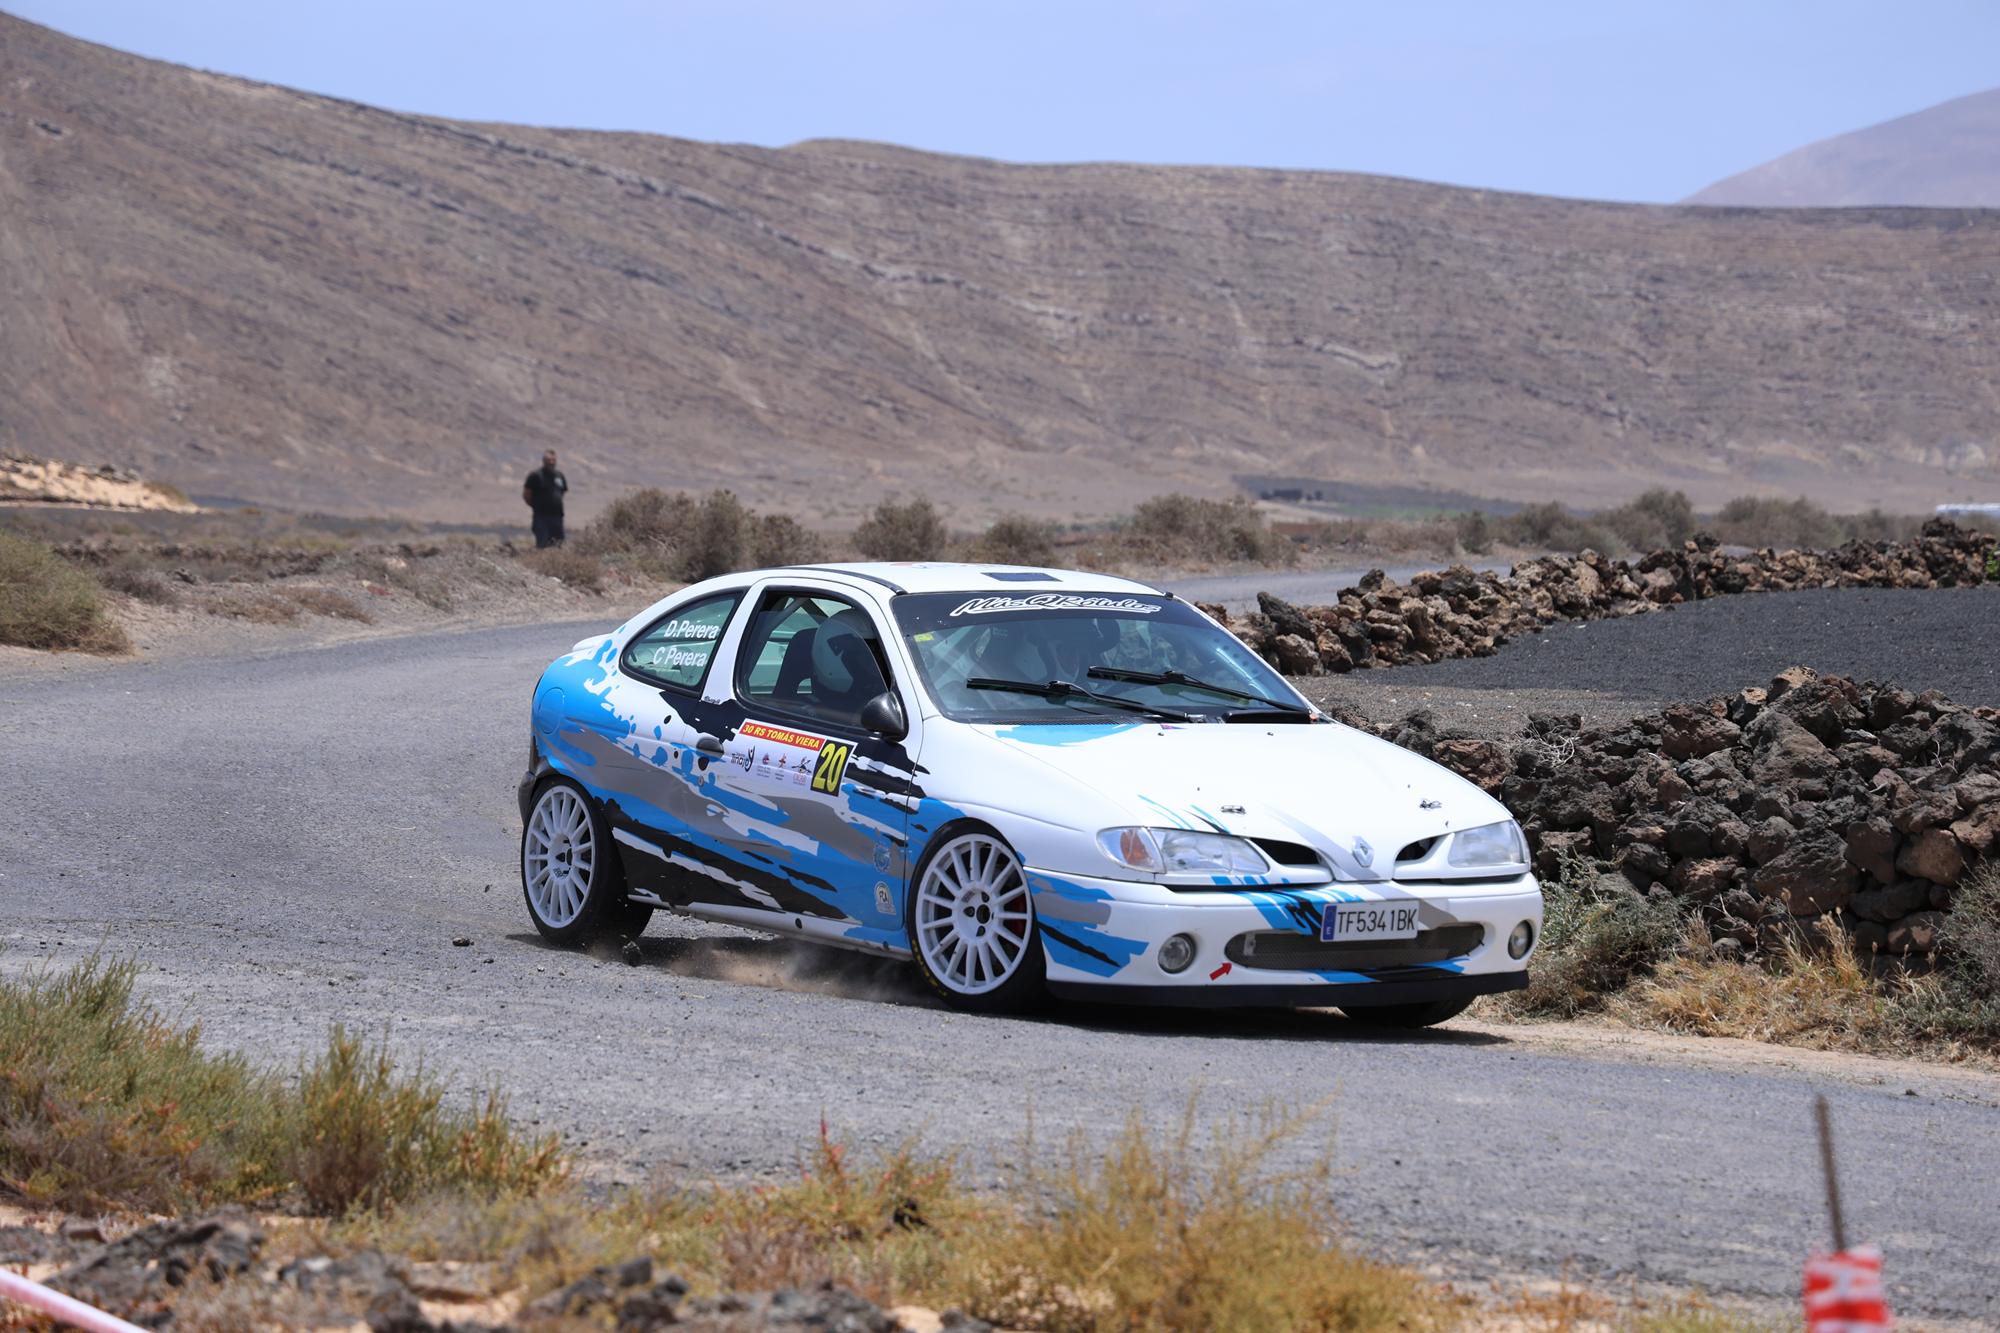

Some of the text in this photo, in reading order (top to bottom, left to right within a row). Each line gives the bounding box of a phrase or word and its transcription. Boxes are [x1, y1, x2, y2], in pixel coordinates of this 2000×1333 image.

[664, 620, 719, 639] D.Perera
[653, 647, 707, 667] C Perera
[742, 724, 820, 749] 30 RS TOMÁS VIERA
[812, 743, 848, 793] 20
[1337, 908, 1418, 933] TF5341BK
